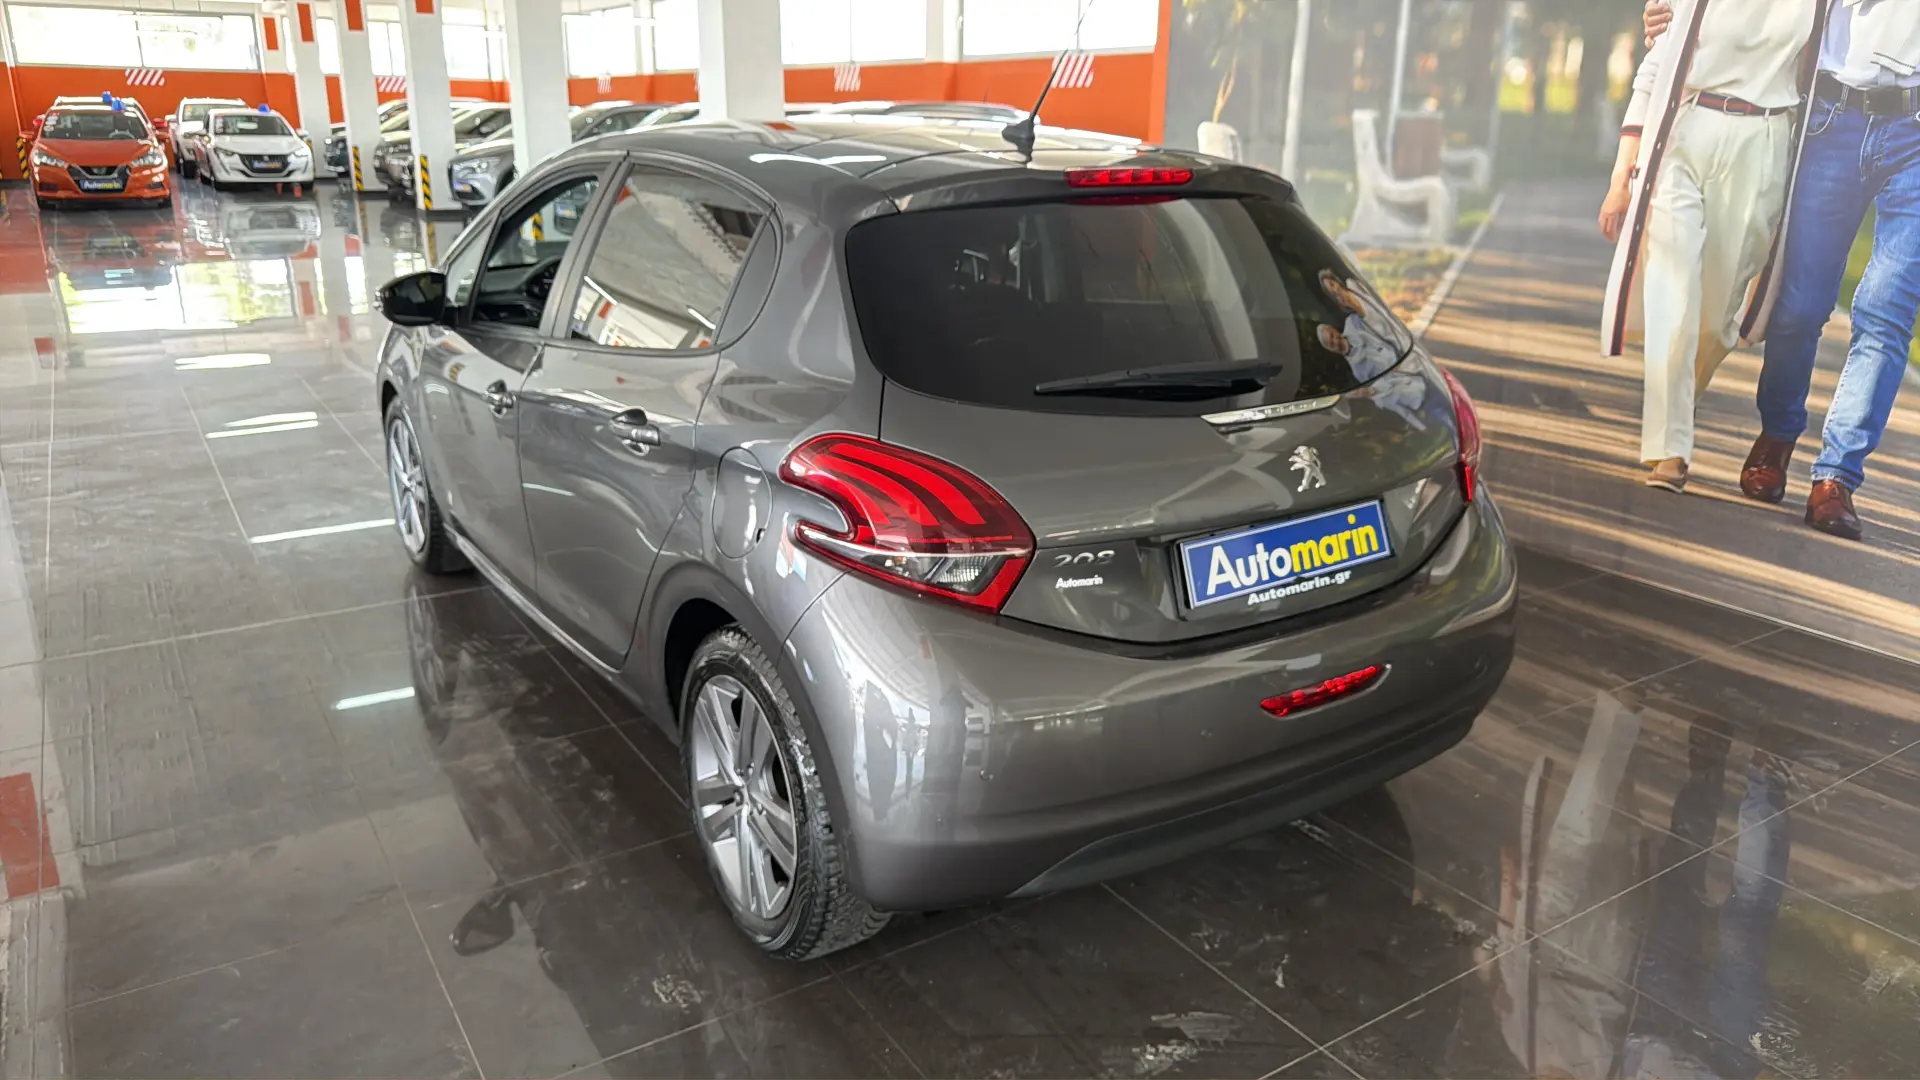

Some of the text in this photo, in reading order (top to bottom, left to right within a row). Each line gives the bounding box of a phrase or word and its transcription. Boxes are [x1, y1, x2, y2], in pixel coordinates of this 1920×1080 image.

[1053, 550, 1115, 568] 208
[1206, 514, 1379, 595] Automarin
[1055, 574, 1104, 589] Automarin
[1247, 570, 1352, 606] Automarin.gr
